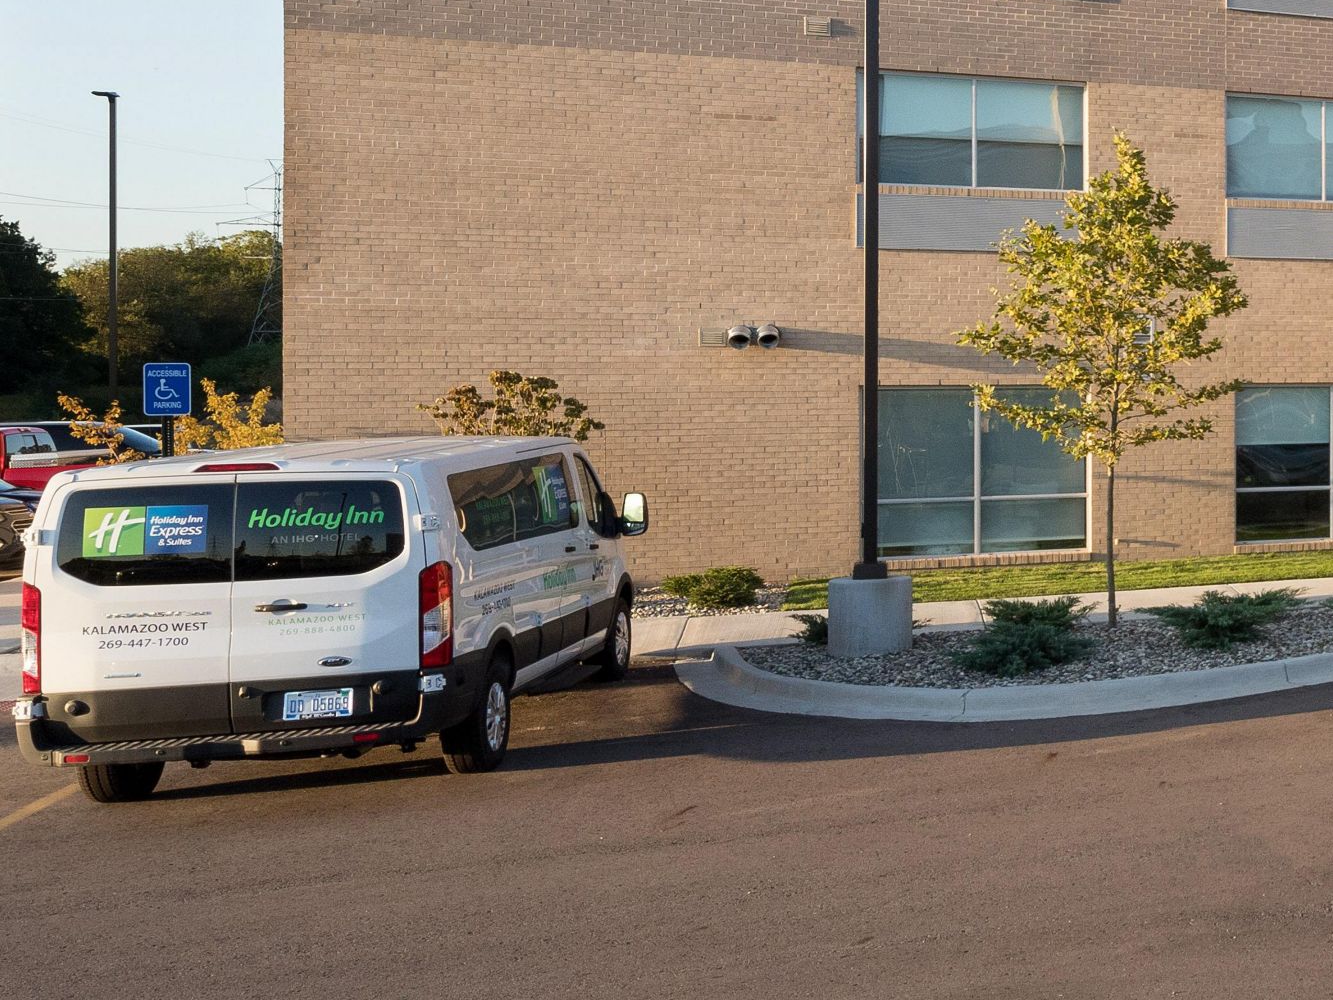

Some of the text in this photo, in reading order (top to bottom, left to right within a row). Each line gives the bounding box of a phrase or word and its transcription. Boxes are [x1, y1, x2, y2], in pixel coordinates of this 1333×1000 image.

[153, 401, 182, 409] PARKING
[150, 514, 203, 526] Holiday Inn
[248, 505, 385, 530] Holiday Inn
[158, 537, 193, 547] & Suites
[271, 535, 288, 544] AN
[320, 532, 361, 542] HOTEL
[268, 613, 367, 626] KALAMAZOO WEST
[82, 621, 208, 636] KALAMAZOO WEST
[98, 636, 189, 650] 269-447-1700
[313, 697, 349, 712] 05869
